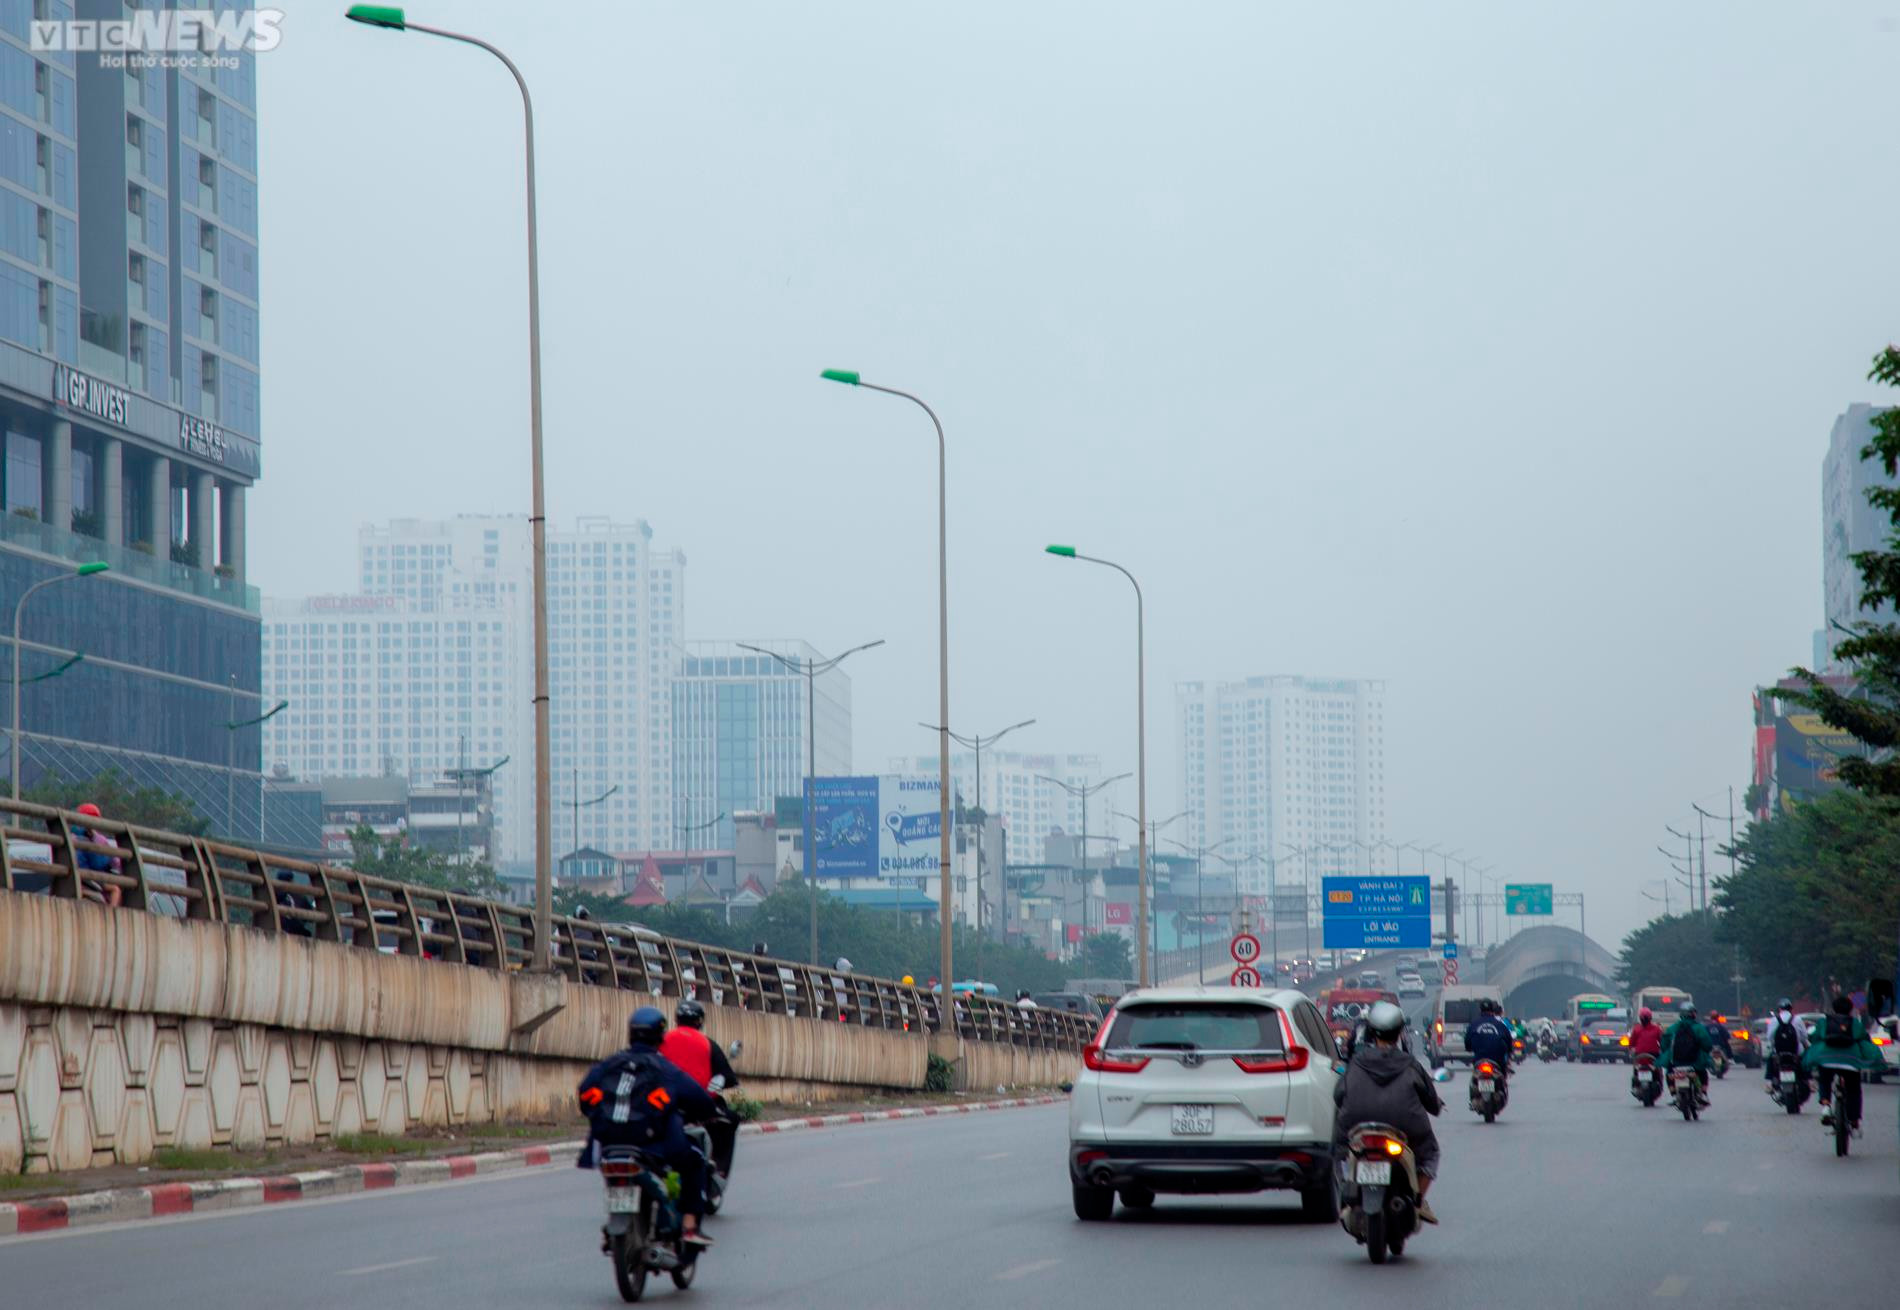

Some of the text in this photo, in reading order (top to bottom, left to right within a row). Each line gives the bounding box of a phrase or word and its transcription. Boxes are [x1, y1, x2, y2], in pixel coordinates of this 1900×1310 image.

[69, 371, 130, 426] GP.INVEST
[899, 780, 941, 791] BIZMAN
[1359, 881, 1380, 890] VÀNH
[1374, 893, 1385, 903] HÀ
[1382, 920, 1399, 932] VÀO
[1364, 935, 1400, 944] ENTRANCE
[1238, 943, 1251, 955] 60
